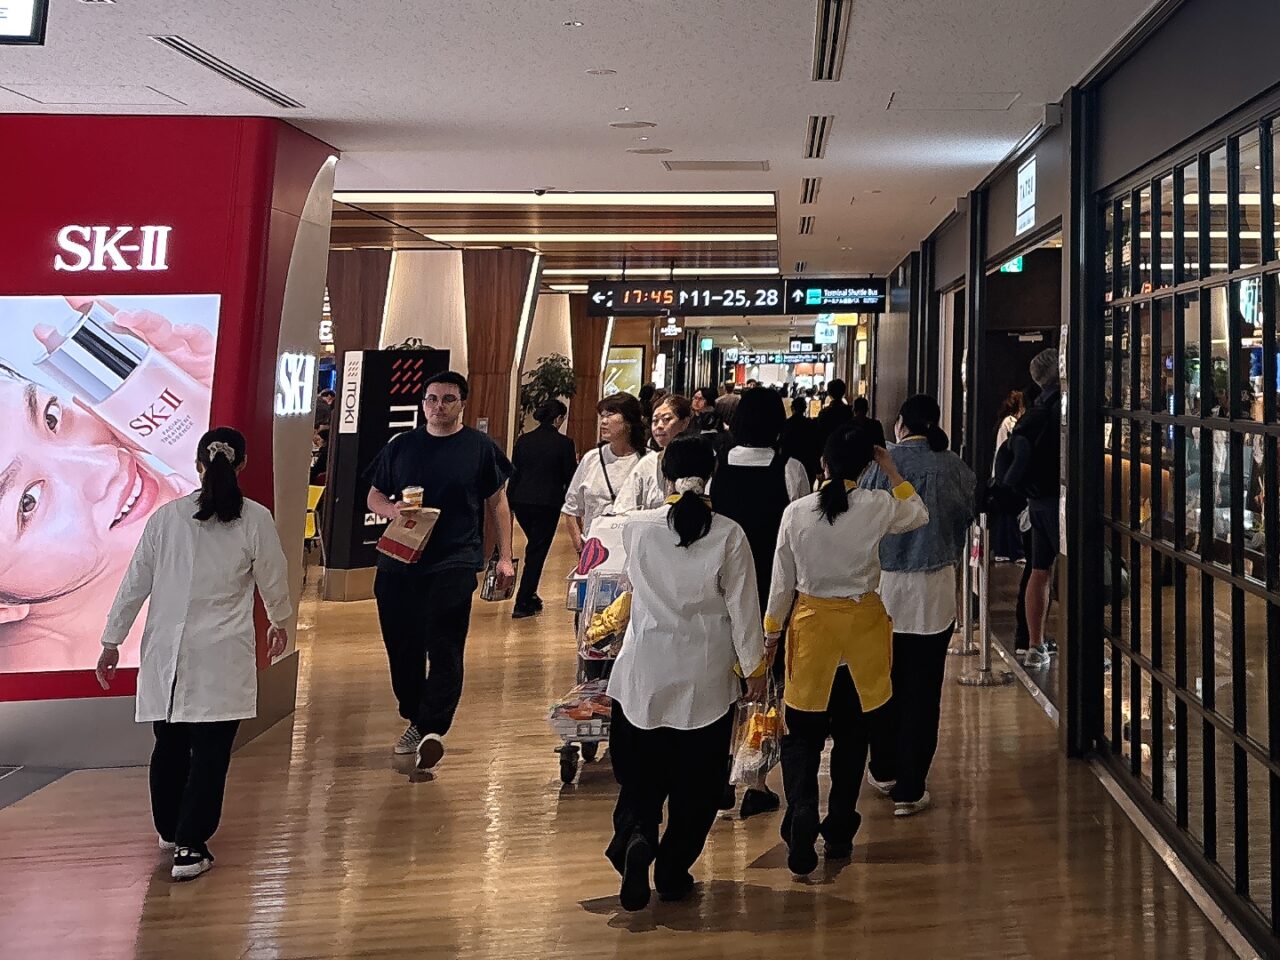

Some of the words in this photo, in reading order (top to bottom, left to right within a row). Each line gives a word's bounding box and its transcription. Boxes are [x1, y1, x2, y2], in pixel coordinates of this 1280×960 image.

[54, 225, 172, 271] SK-II
[623, 290, 674, 304] 17:45
[755, 289, 779, 306] 28
[129, 387, 183, 437] SK-II
[344, 382, 357, 424] ITOKI
[162, 418, 181, 435] FACIAL
